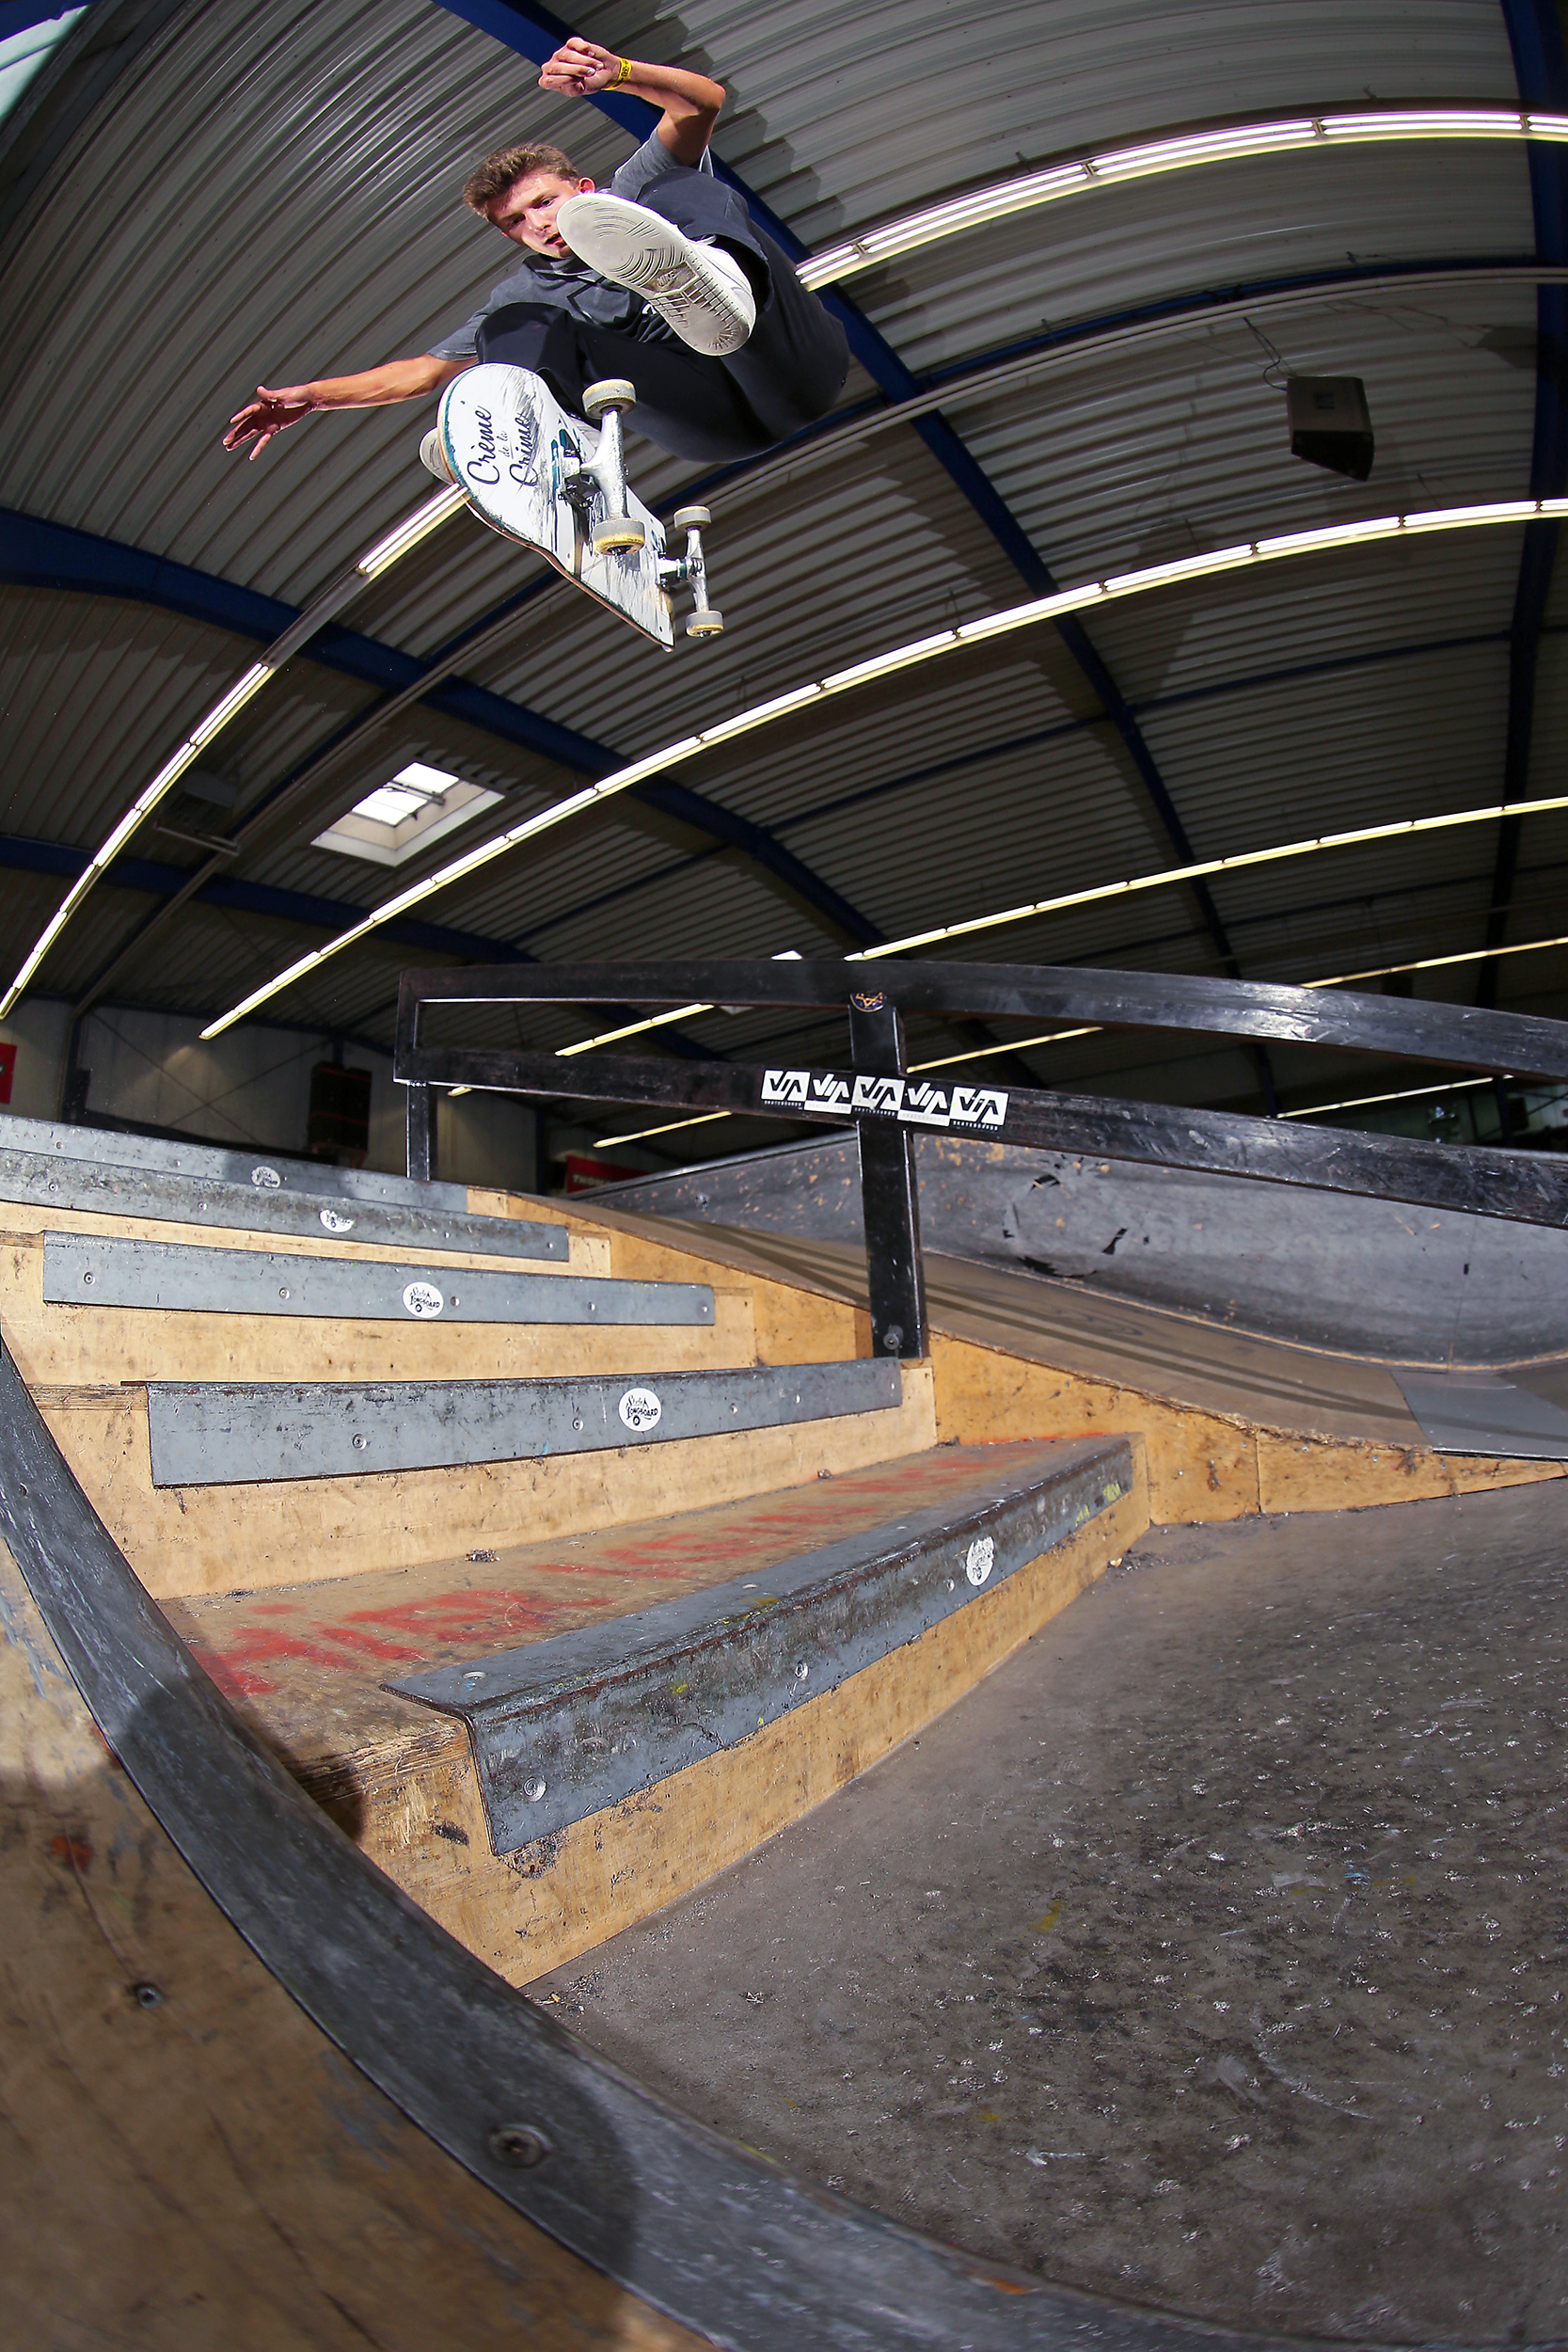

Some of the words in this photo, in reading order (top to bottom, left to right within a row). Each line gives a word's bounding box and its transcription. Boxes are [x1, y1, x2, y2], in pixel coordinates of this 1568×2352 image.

[657, 270, 674, 287] NIKE
[467, 405, 499, 485] Crème
[498, 445, 511, 458] de
